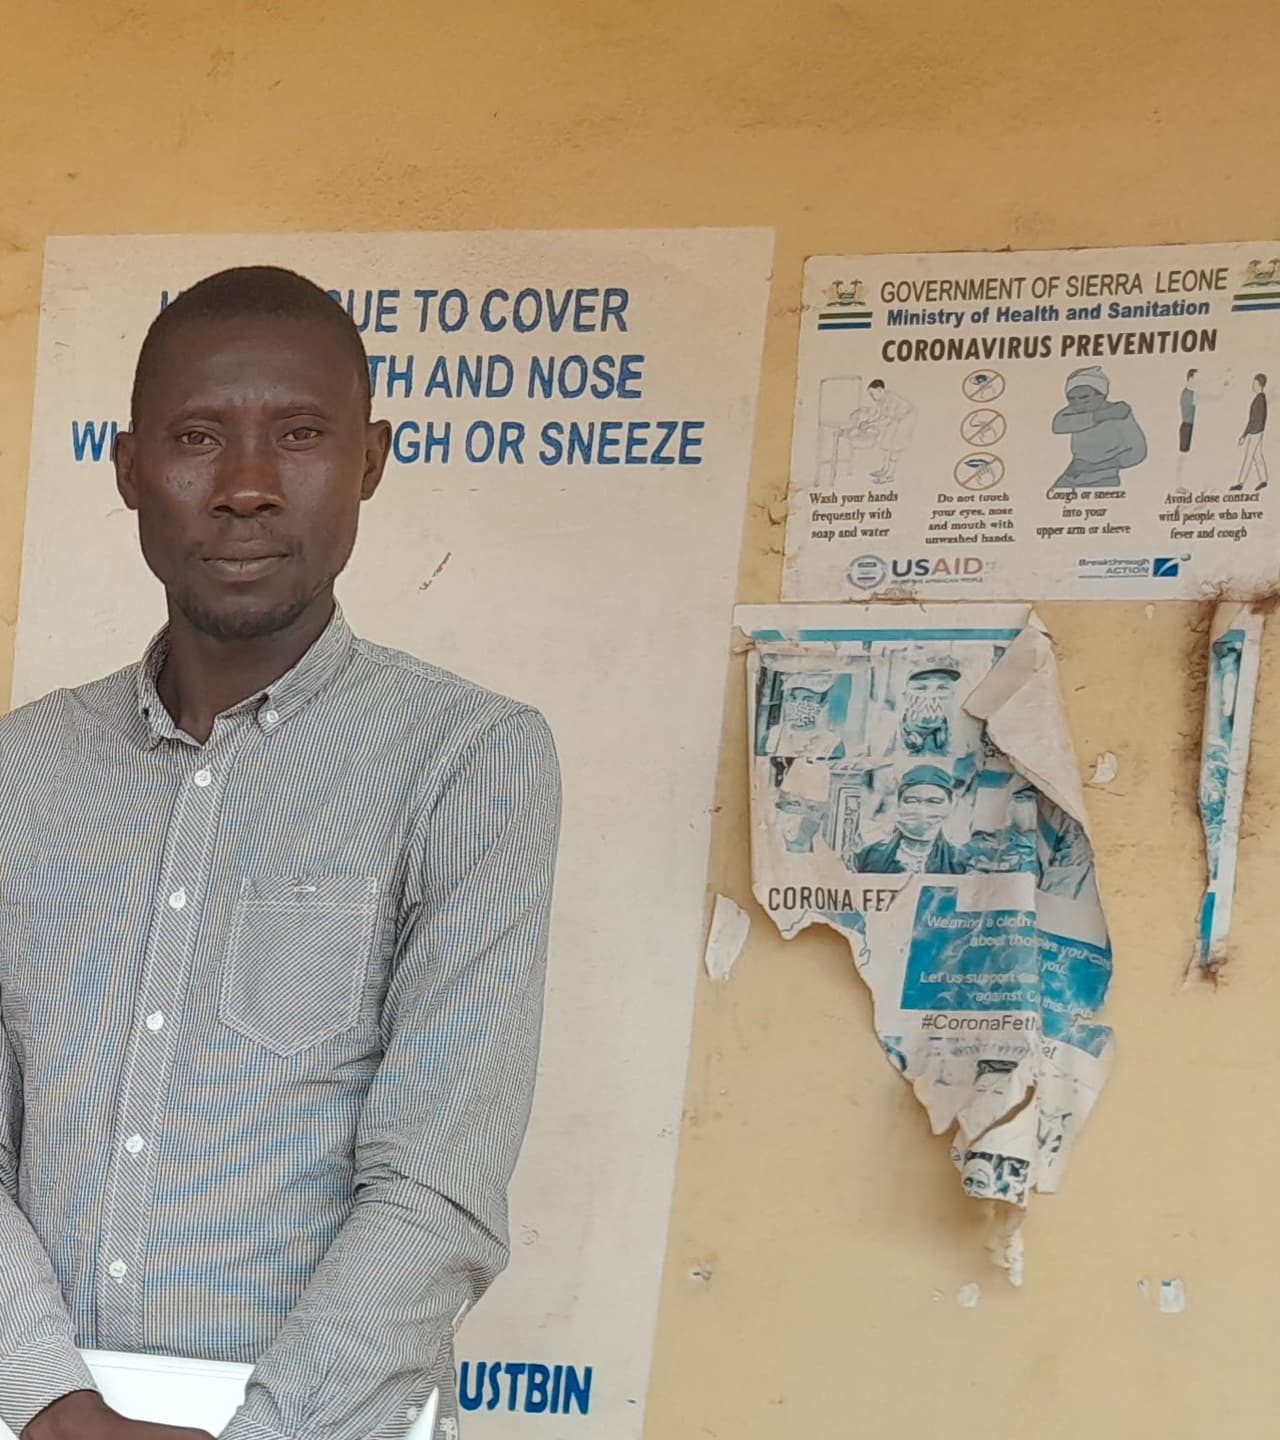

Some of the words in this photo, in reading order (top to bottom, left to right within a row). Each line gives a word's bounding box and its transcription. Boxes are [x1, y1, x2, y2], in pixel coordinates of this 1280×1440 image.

[881, 277, 1026, 303] GOVERNMENT
[1032, 276, 1060, 298] OF
[1066, 273, 1143, 297] SIERRA
[1155, 268, 1230, 294] LEONE
[326, 289, 400, 332] UE
[414, 288, 469, 333] TO
[480, 288, 630, 333] COVER
[887, 307, 964, 328] Ministry
[971, 307, 990, 324] of
[997, 304, 1059, 323] Health
[1066, 302, 1101, 321] and
[1107, 300, 1210, 319] Sanitation
[882, 335, 1052, 362] CORONAVIRUS
[1060, 329, 1217, 358] PREVENTION
[425, 354, 514, 398] AND
[528, 354, 645, 399] NOSE
[465, 420, 526, 464] OR
[539, 421, 705, 465] SNEEZE
[809, 492, 838, 504] Wash
[840, 495, 865, 507] your
[868, 490, 898, 503] hands
[937, 494, 954, 503] Do
[957, 494, 975, 502] not
[1046, 489, 1078, 503] Cough
[1081, 491, 1092, 499] or
[1195, 493, 1220, 503] close
[812, 510, 866, 525] frequently
[869, 508, 892, 520] with
[1062, 506, 1083, 517] into
[1085, 508, 1107, 520] your
[1183, 511, 1215, 524] people
[1218, 511, 1238, 521] who
[811, 530, 836, 542] soap
[838, 527, 857, 539] and
[861, 527, 890, 537] water
[928, 521, 947, 531] and
[951, 521, 986, 531] mouth
[1036, 525, 1065, 539] upper
[1197, 528, 1215, 539] and
[891, 558, 984, 577] USAID
[768, 887, 853, 912] CORONA
[459, 1361, 592, 1415] USTBIN
